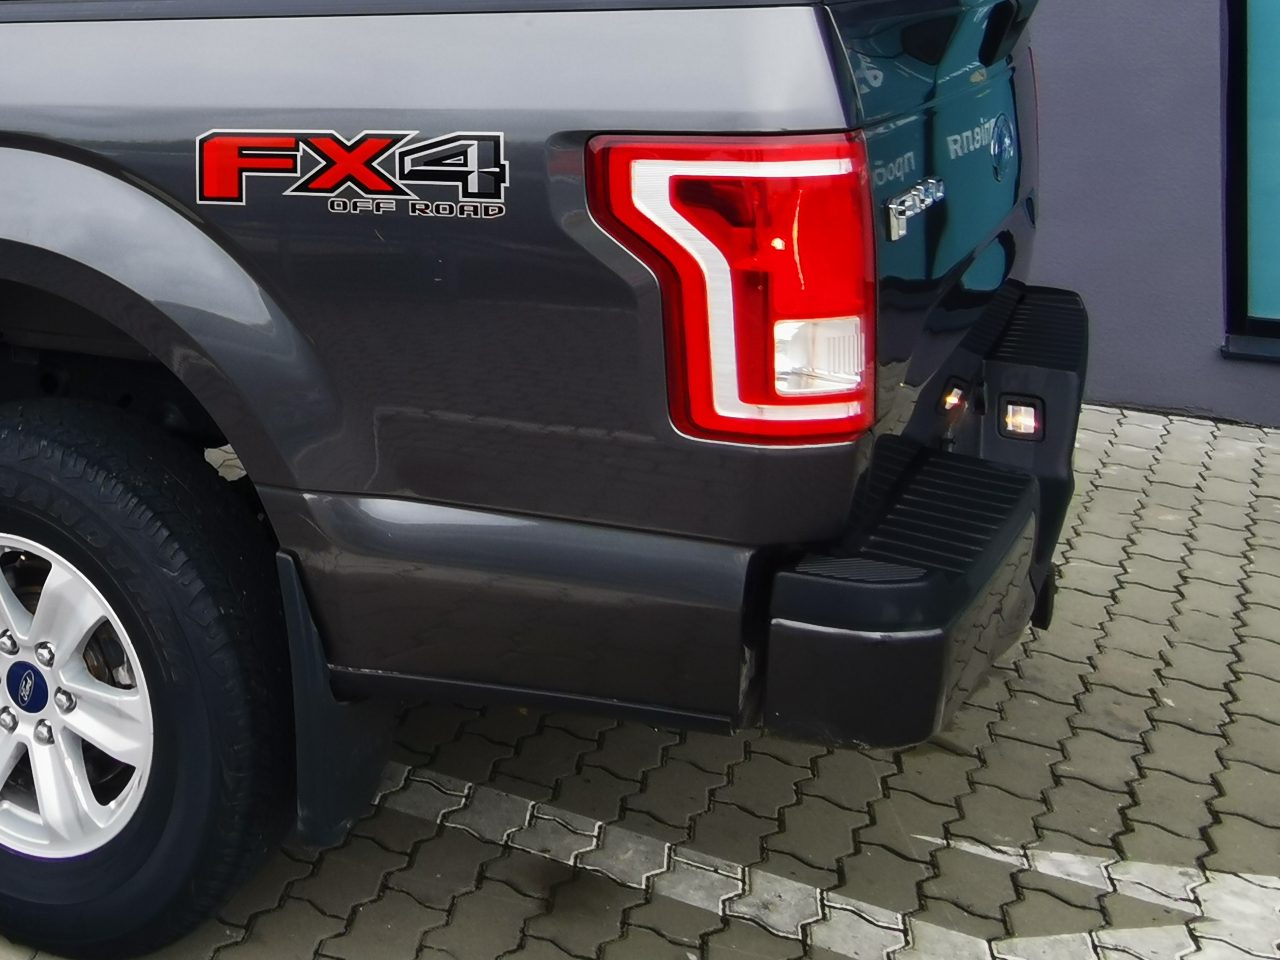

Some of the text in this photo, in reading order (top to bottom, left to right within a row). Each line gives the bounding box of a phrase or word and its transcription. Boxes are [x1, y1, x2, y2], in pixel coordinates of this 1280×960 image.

[196, 129, 510, 205] FX4
[328, 197, 506, 219] OFF ROAD
